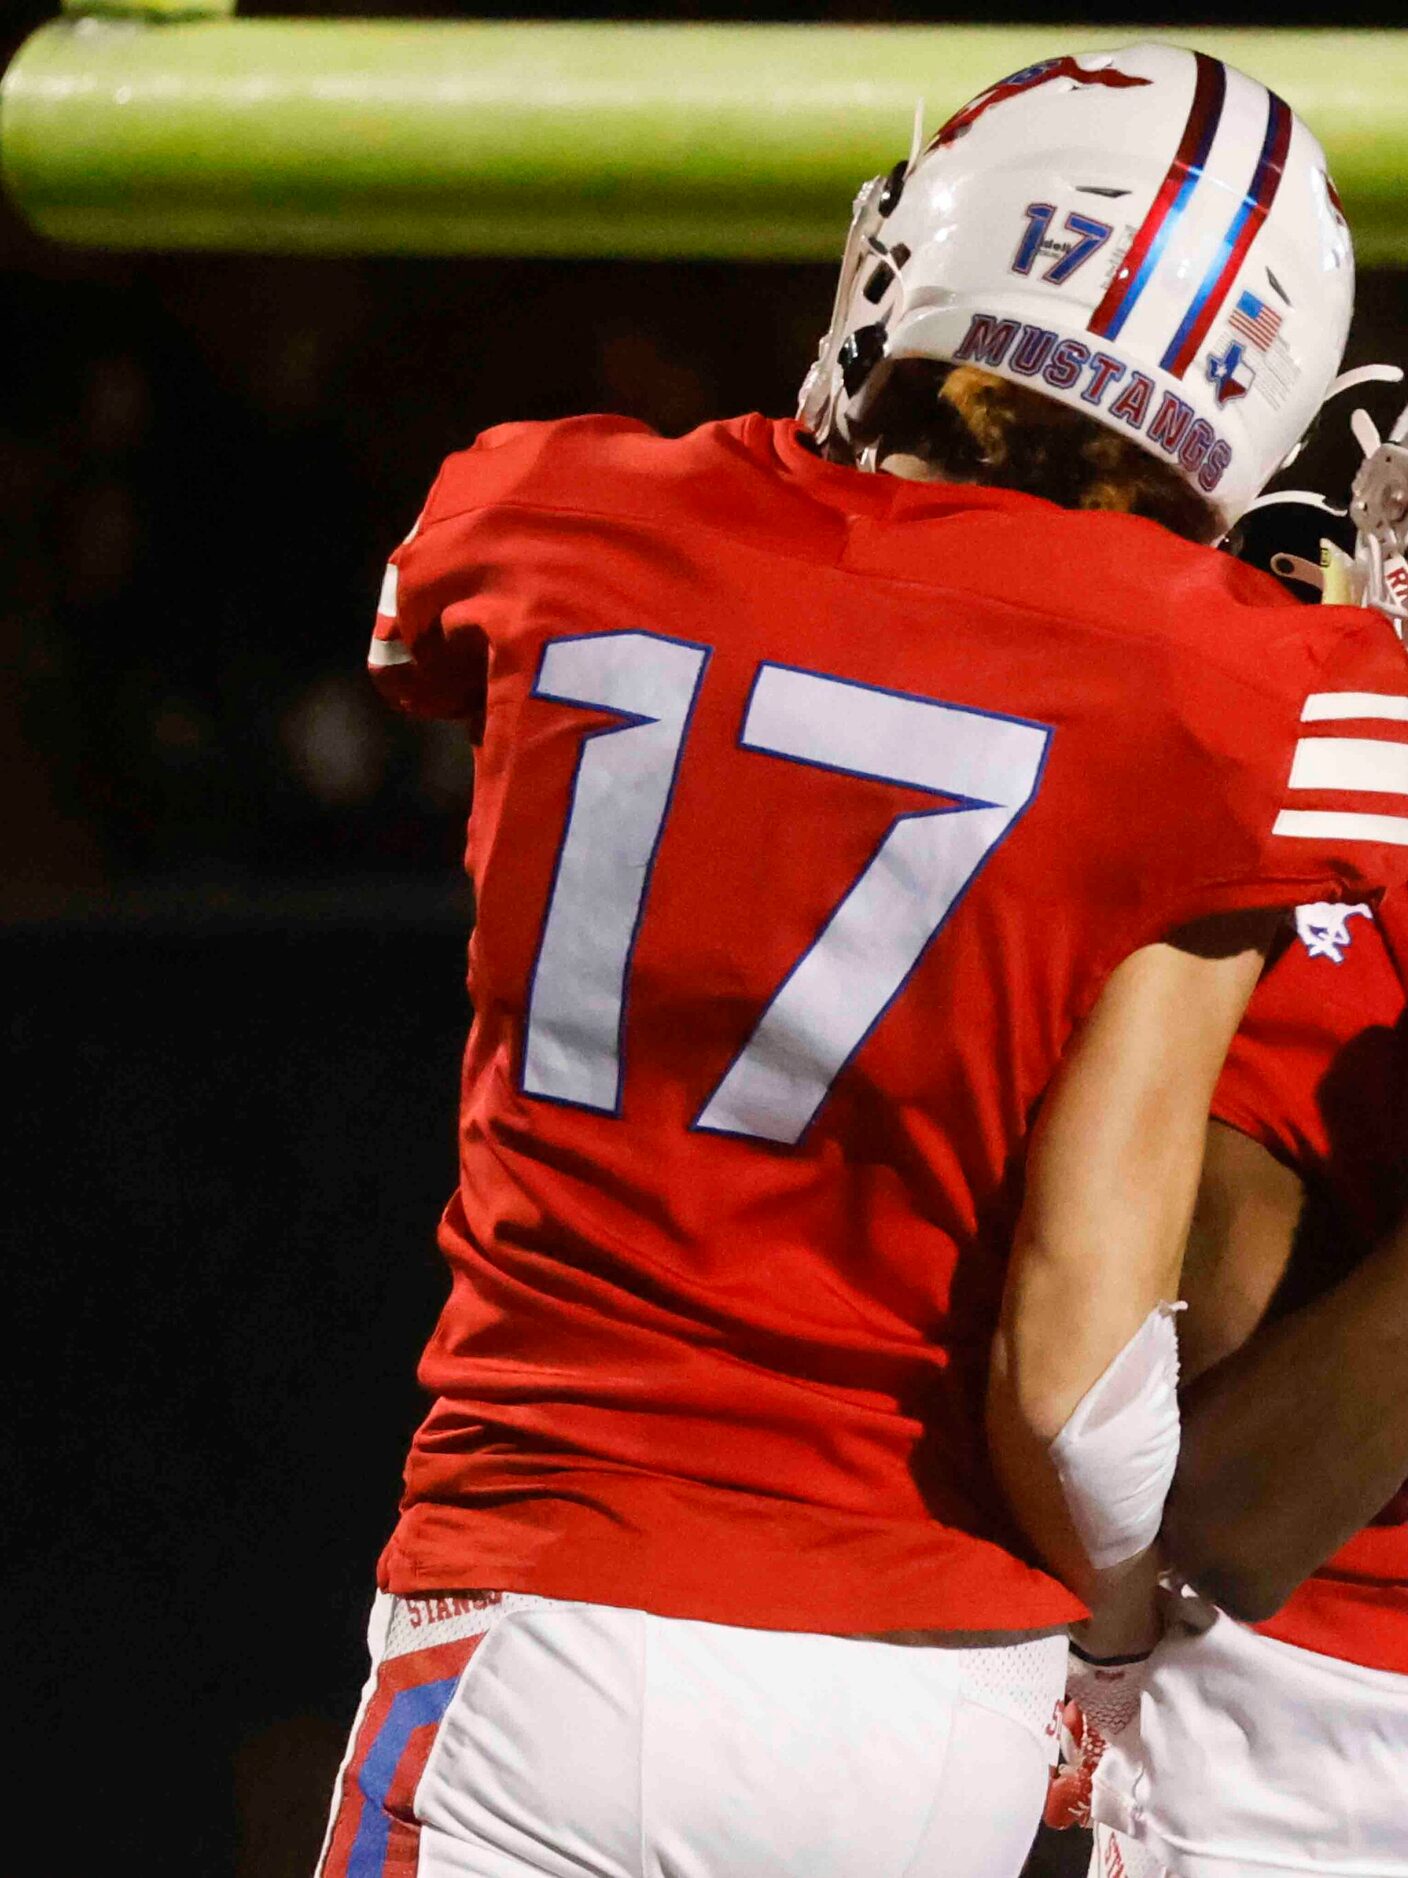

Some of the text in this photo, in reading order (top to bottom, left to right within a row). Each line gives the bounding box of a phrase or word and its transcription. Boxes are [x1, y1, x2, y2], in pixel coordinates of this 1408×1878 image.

[1011, 203, 1114, 285] 17
[952, 313, 1232, 492] MUSTANGS
[519, 628, 1055, 1147] 17
